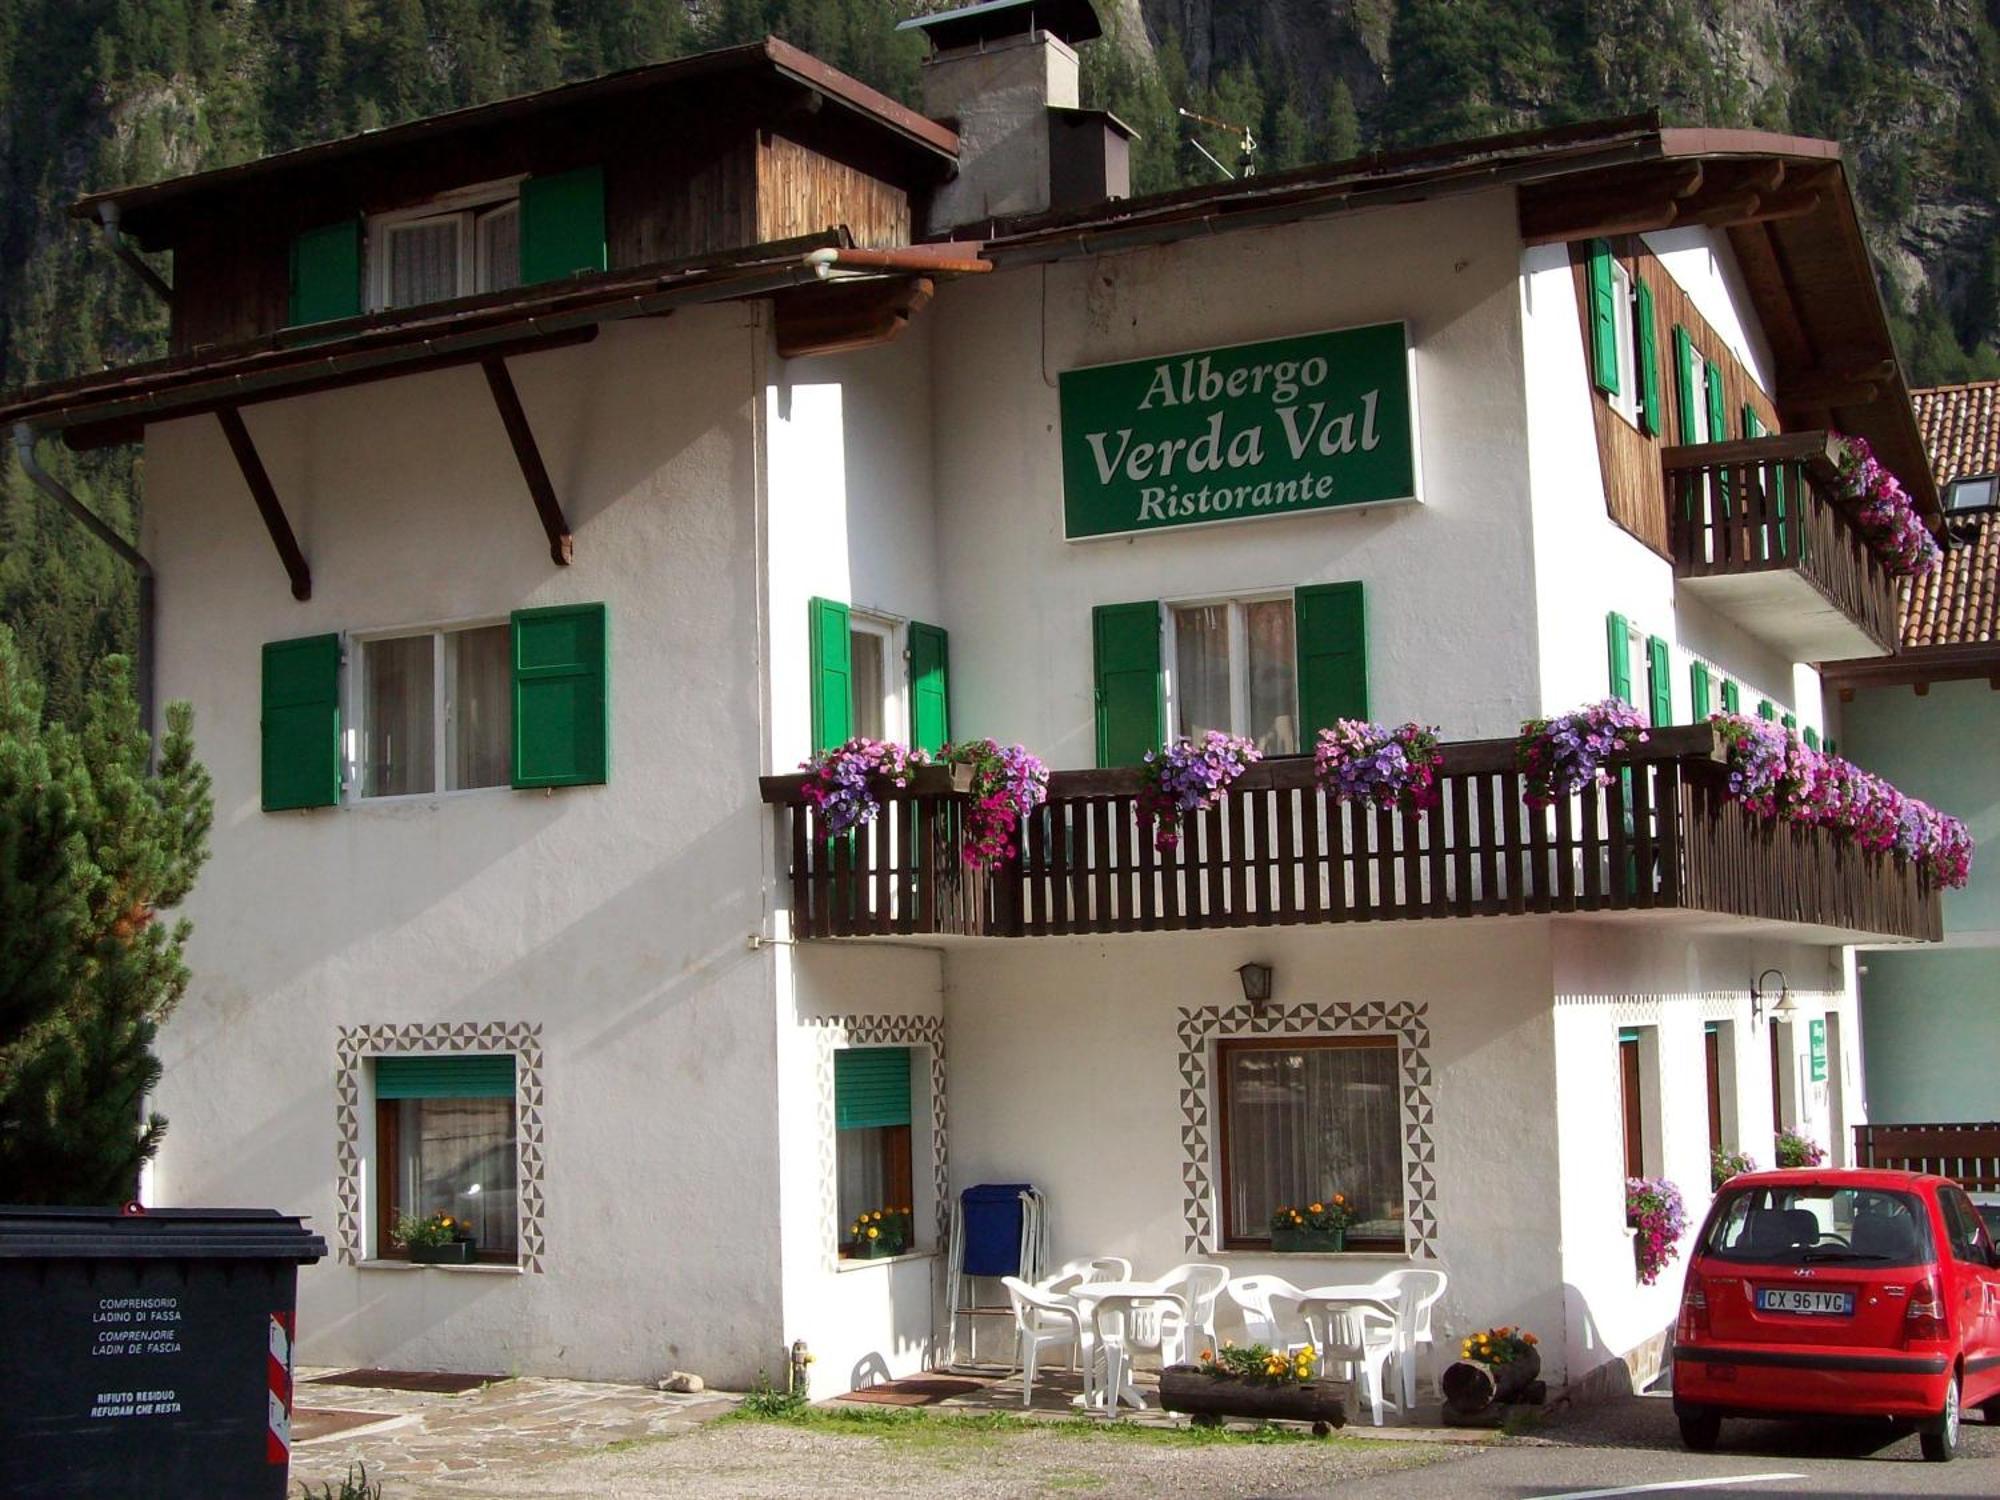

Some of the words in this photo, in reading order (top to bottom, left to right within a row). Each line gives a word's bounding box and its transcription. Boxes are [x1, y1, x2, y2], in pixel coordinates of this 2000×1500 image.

[1137, 356, 1328, 411] Albergo
[1085, 410, 1265, 486] Verda
[1274, 389, 1381, 461] Val
[1136, 471, 1335, 522] Ristorante
[99, 1298, 177, 1310] COMPRENSORIO
[1767, 1291, 1787, 1308] CX
[92, 1311, 131, 1323] LADINO
[135, 1311, 147, 1322] DI
[151, 1311, 182, 1321] FASSA
[98, 1330, 175, 1342] COMPRENJORIE
[91, 1344, 124, 1356] LADIN
[128, 1343, 142, 1354] DE
[147, 1343, 181, 1353] FASCIA
[97, 1392, 134, 1403] RIFIUTO
[136, 1390, 175, 1402] RESIDUO
[91, 1405, 134, 1417] REFUDAM
[135, 1404, 154, 1415] CHE
[154, 1402, 181, 1414] RESTA
